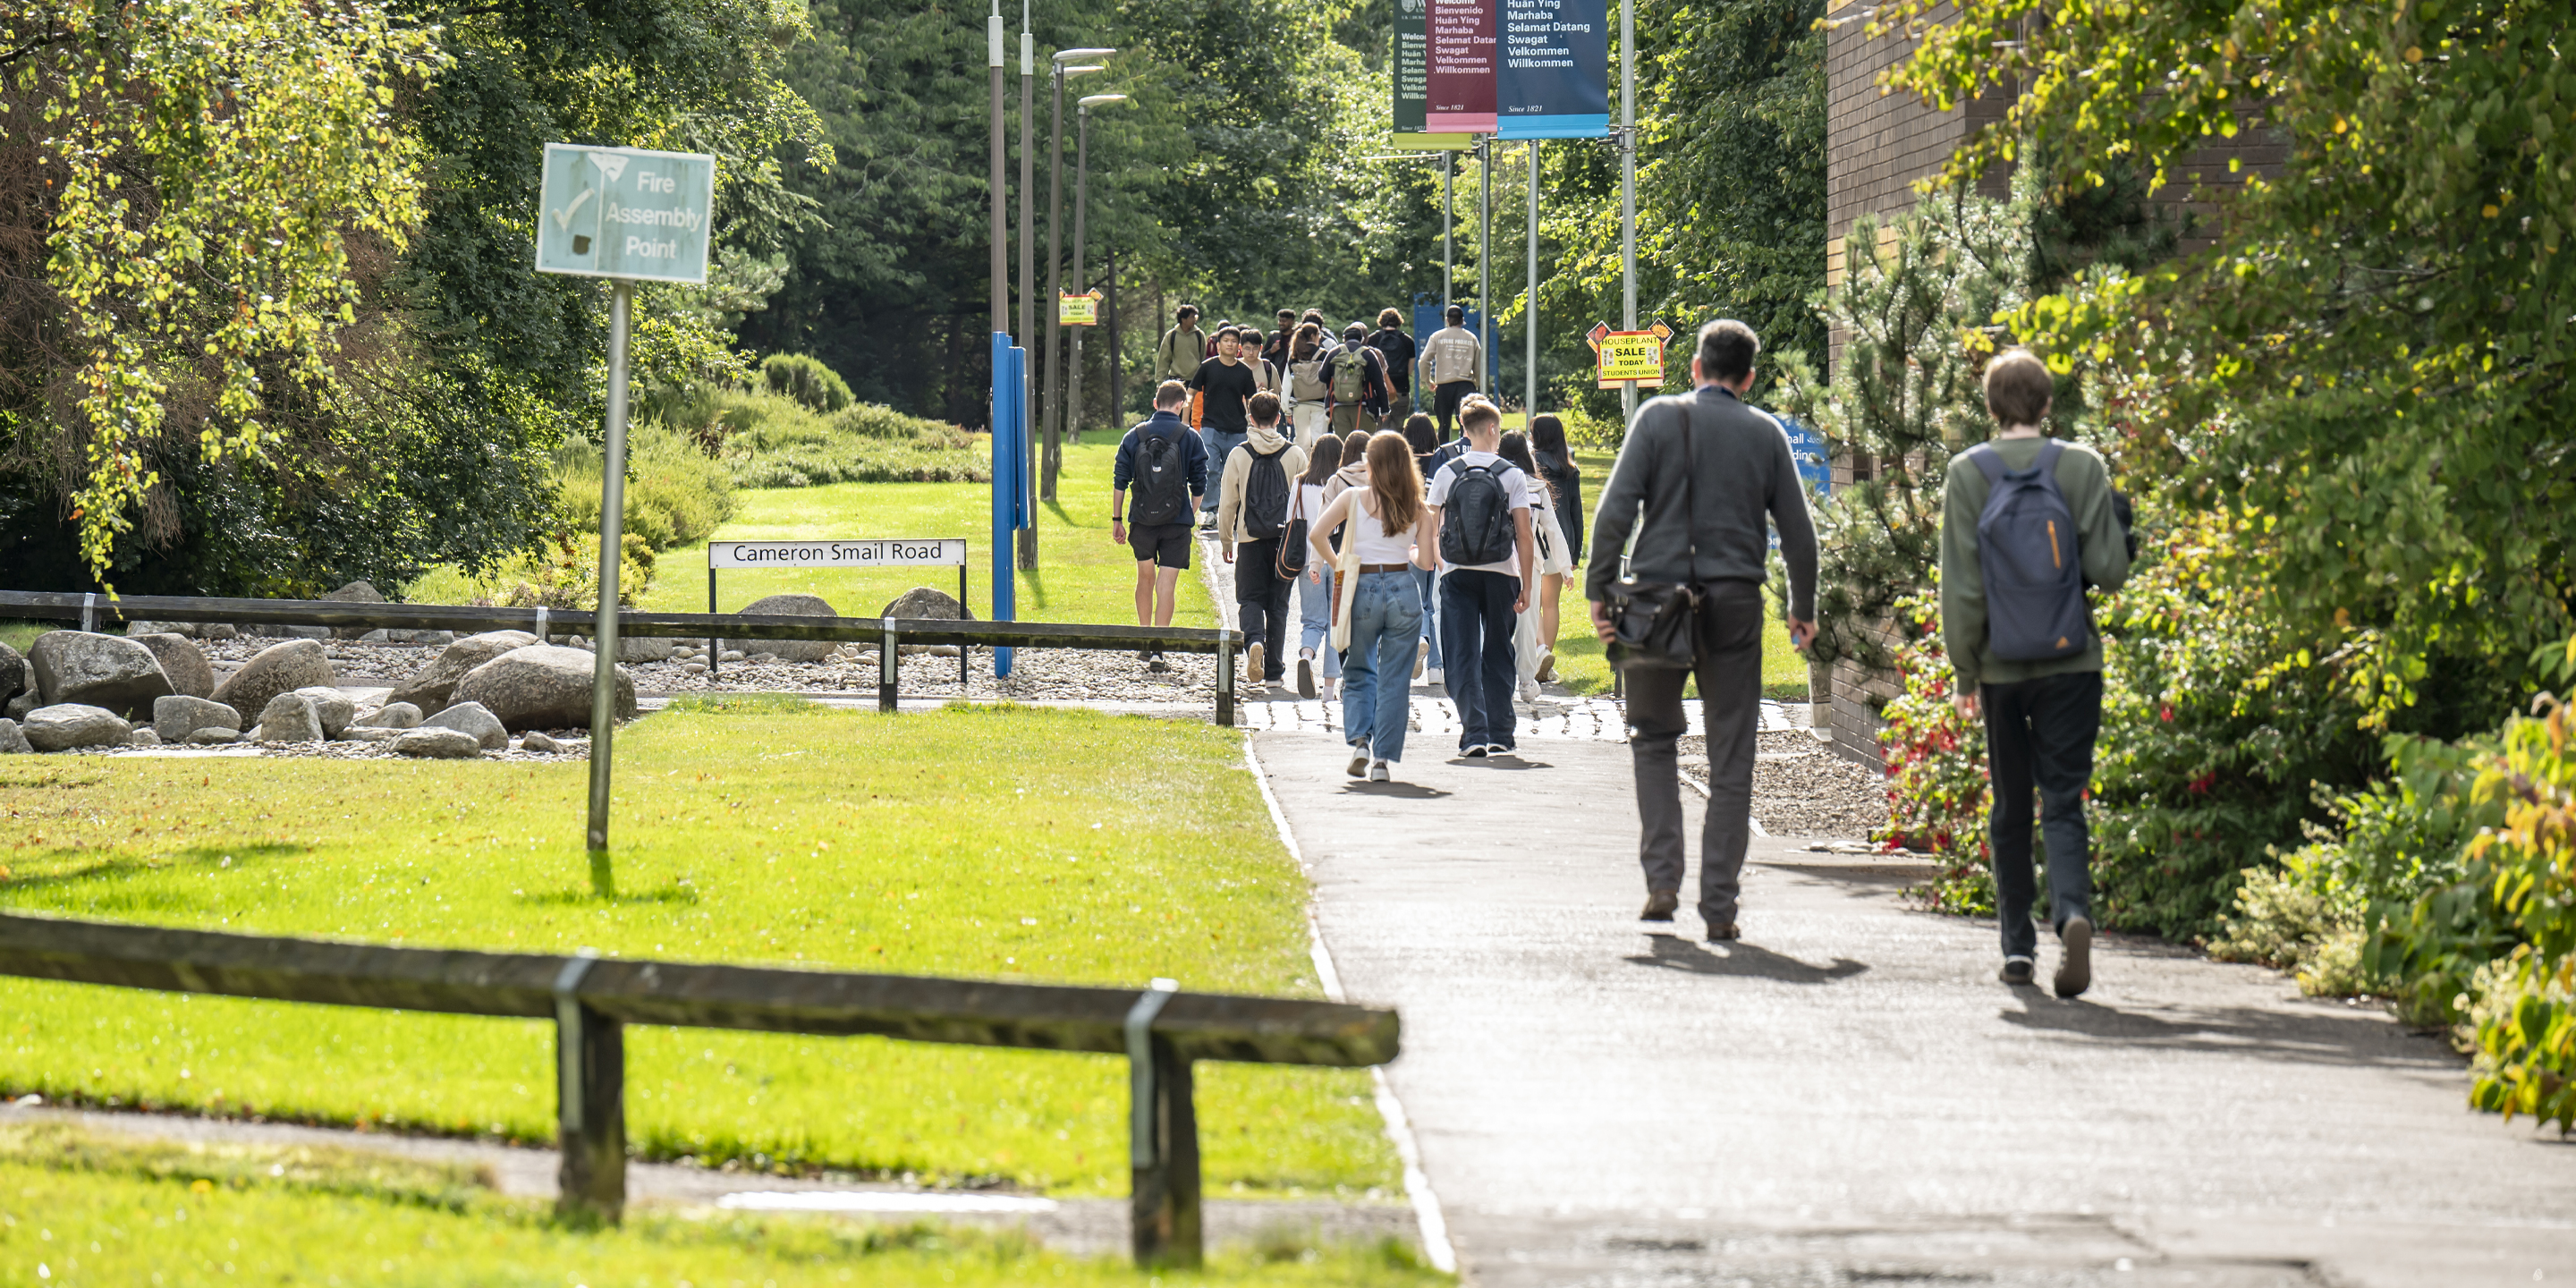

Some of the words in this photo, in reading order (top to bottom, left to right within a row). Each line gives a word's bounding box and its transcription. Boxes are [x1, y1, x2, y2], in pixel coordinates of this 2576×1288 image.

[1435, 6, 1484, 14] Bienvenido
[1507, 10, 1554, 21] Marhaba
[1435, 26, 1474, 34] Marhaba
[1507, 22, 1551, 32] Selamat
[1553, 21, 1590, 33] Datang
[1435, 36, 1471, 45] Selamat
[1507, 35, 1548, 46] Swagat
[1435, 46, 1469, 55] Swagat
[1507, 47, 1570, 56] Velkommen
[1435, 55, 1487, 64] Velkommen
[1507, 58, 1574, 68] Willkommen
[1435, 65, 1491, 74] Willkommen
[1508, 105, 1525, 114] Since
[1526, 105, 1543, 113] 1821
[637, 171, 675, 194] Fire
[605, 201, 703, 233] Assembly
[626, 235, 677, 259] Point
[1602, 337, 1657, 345] HOUSEPLANT
[1615, 348, 1645, 356] SALE
[733, 545, 824, 561] Cameron
[831, 542, 884, 561] Smail
[892, 541, 942, 560] Road
